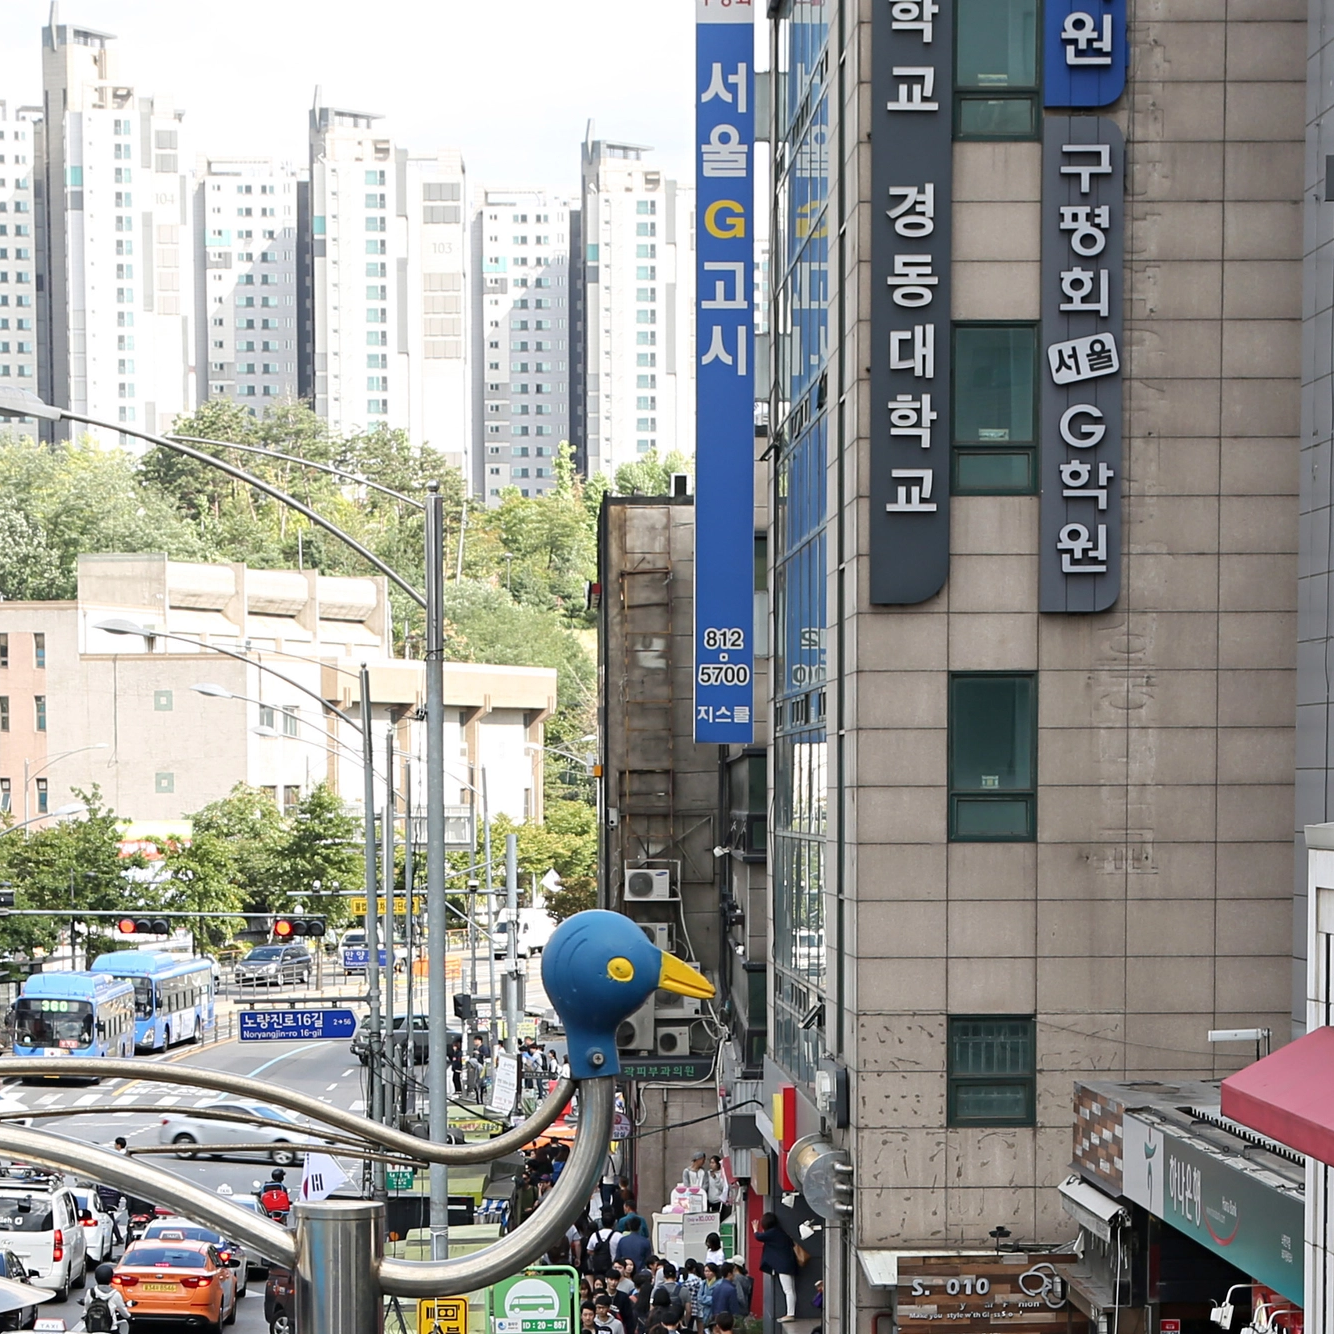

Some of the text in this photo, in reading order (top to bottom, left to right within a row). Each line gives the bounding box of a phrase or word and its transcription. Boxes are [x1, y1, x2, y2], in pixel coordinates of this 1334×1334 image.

[1060, 12, 1112, 66] 원
[1060, 144, 1113, 318] 구평회
[886, 182, 939, 513] 경동대학교
[1054, 338, 1116, 378] 서울
[698, 662, 749, 686] 5700
[697, 704, 750, 726] 지스쿨
[41, 1000, 68, 1012] 360
[243, 1012, 324, 1029] 노량진로16길
[243, 1028, 322, 1039] Noryangjin-ro 16-gil
[1169, 1153, 1202, 1227] 하나은행
[946, 1277, 990, 1295] 010
